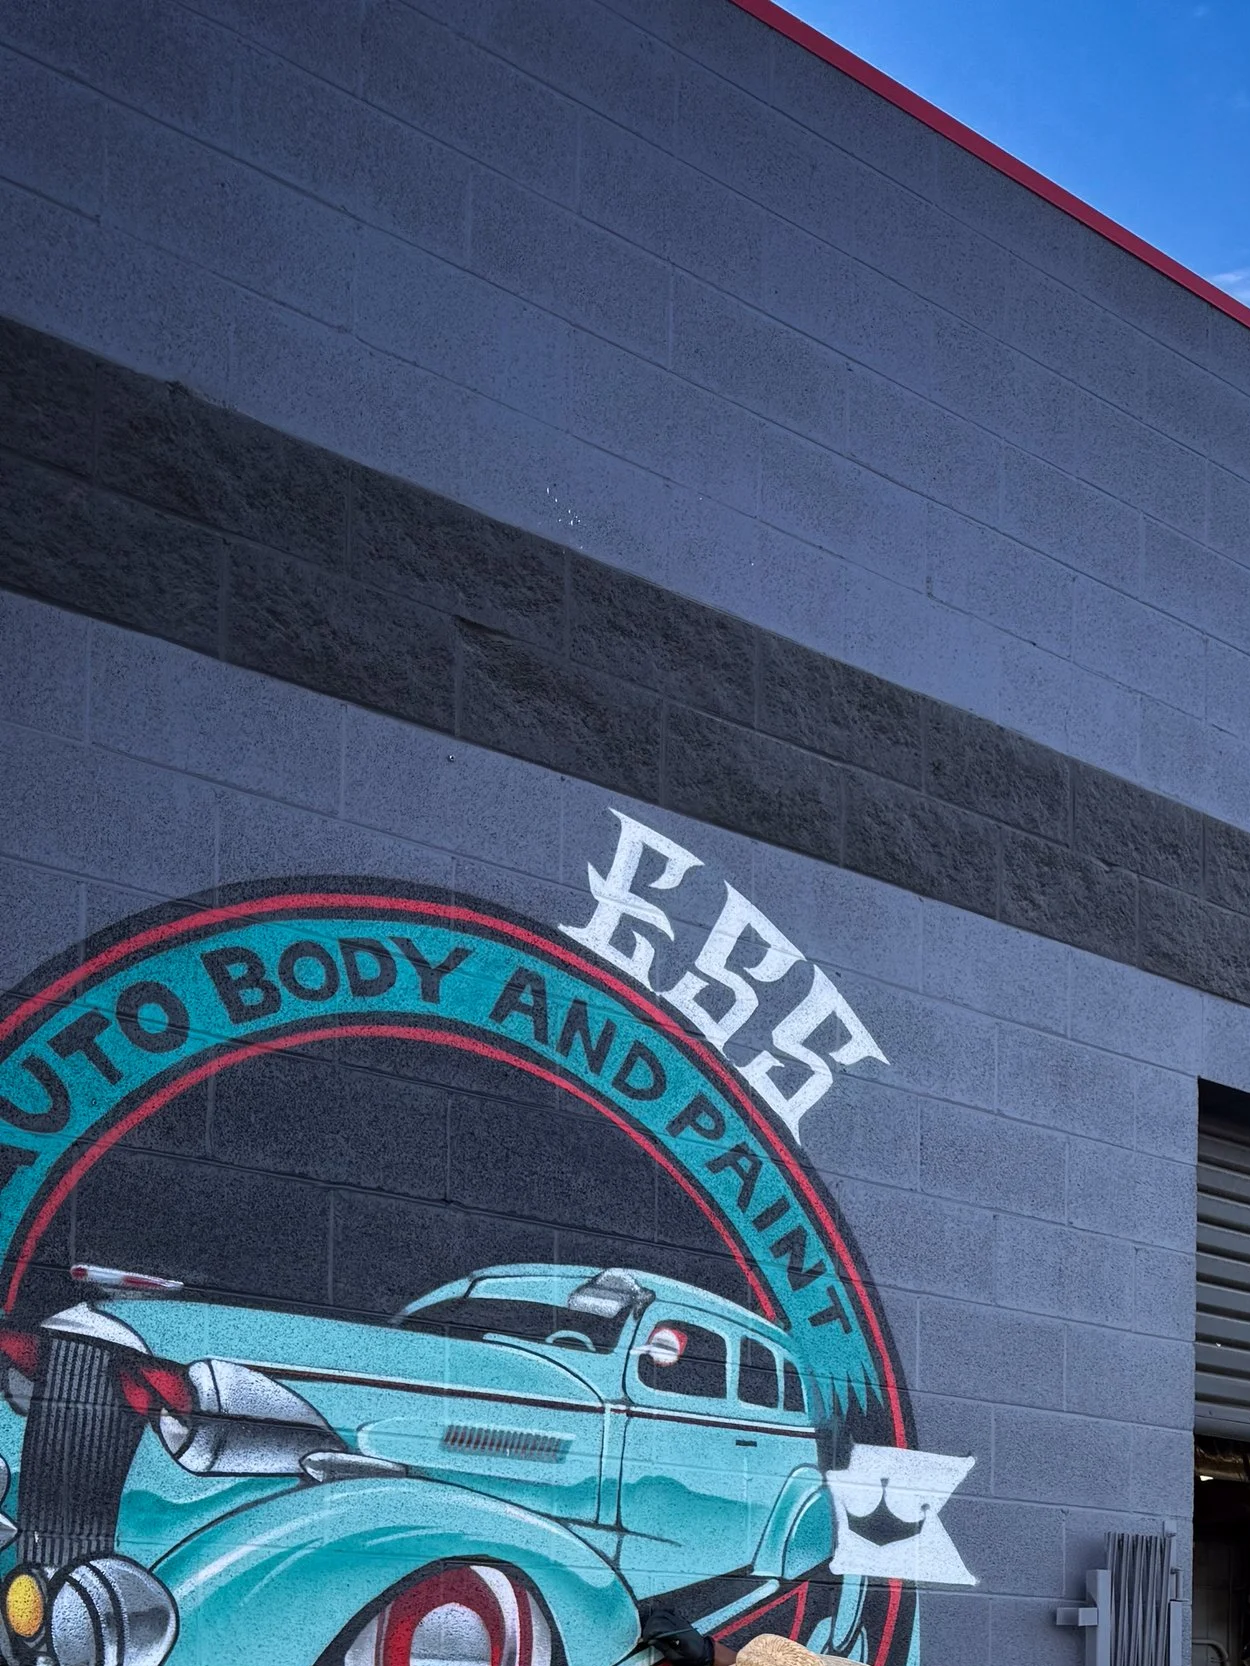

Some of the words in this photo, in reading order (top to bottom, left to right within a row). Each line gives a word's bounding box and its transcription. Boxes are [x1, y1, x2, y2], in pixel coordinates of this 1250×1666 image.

[201, 936, 474, 1025] BODY
[488, 966, 667, 1100] AND
[664, 1092, 852, 1334] PAINT
